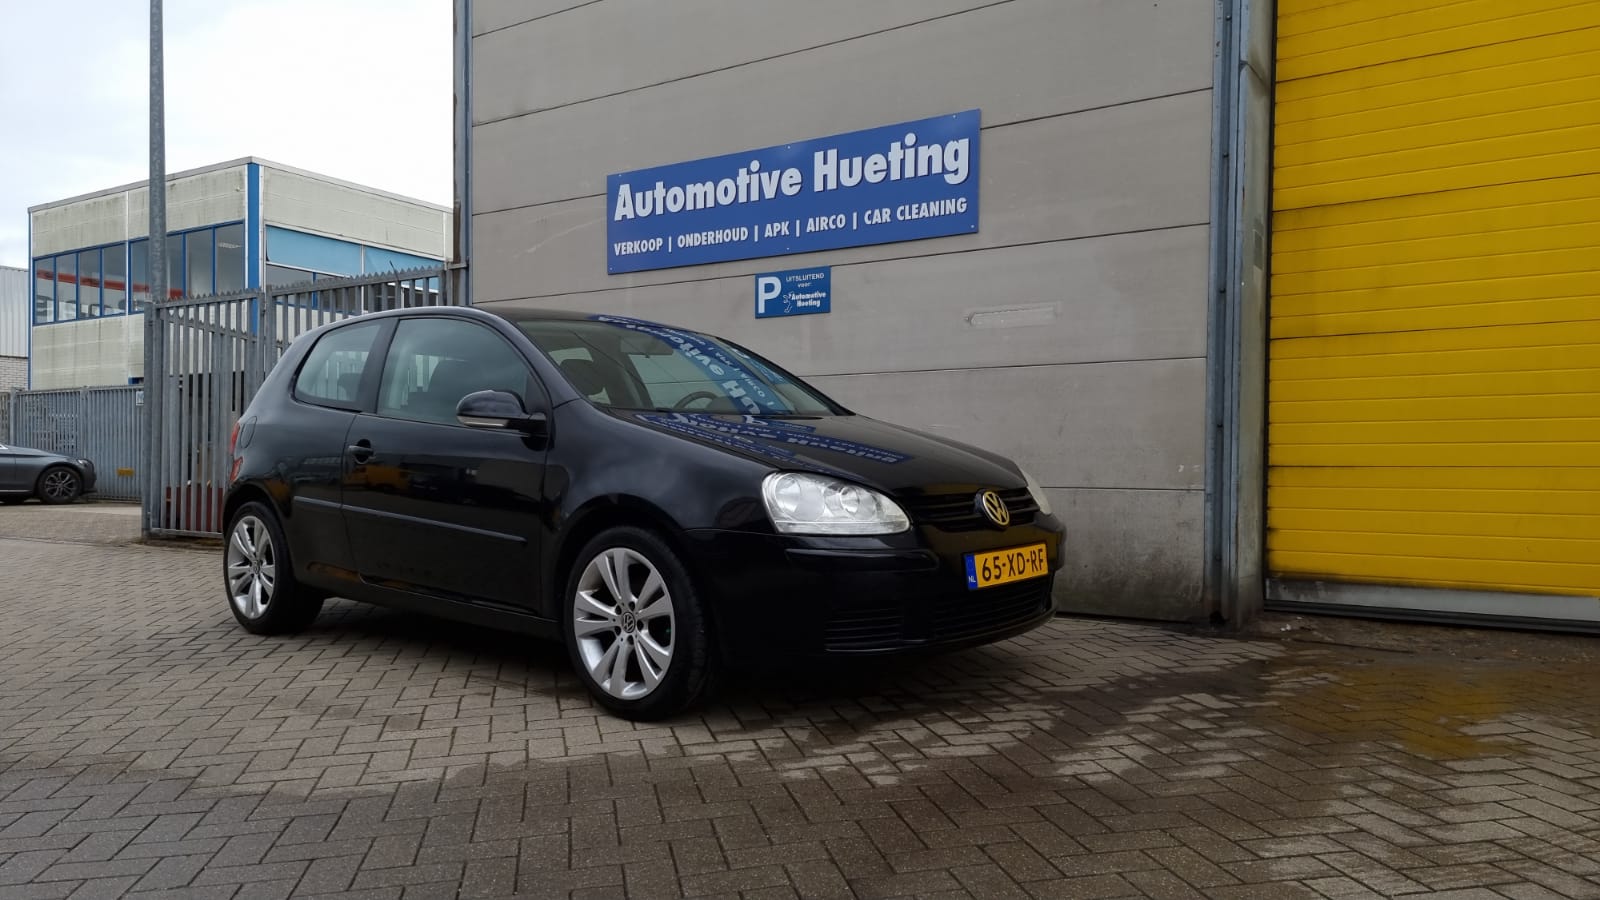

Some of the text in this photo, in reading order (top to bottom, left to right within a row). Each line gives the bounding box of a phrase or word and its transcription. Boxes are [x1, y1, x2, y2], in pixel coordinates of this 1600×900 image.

[614, 133, 969, 221] Automotive Hueting
[614, 197, 967, 256] VERKOOP ONDERHOUD APK AIRCO CAR CLEANING
[786, 273, 824, 282] UITSLUITEND
[759, 277, 782, 313] P
[791, 291, 826, 300] Automotive
[797, 299, 821, 307] Hueting
[982, 548, 1043, 581] 65-XD-RF
